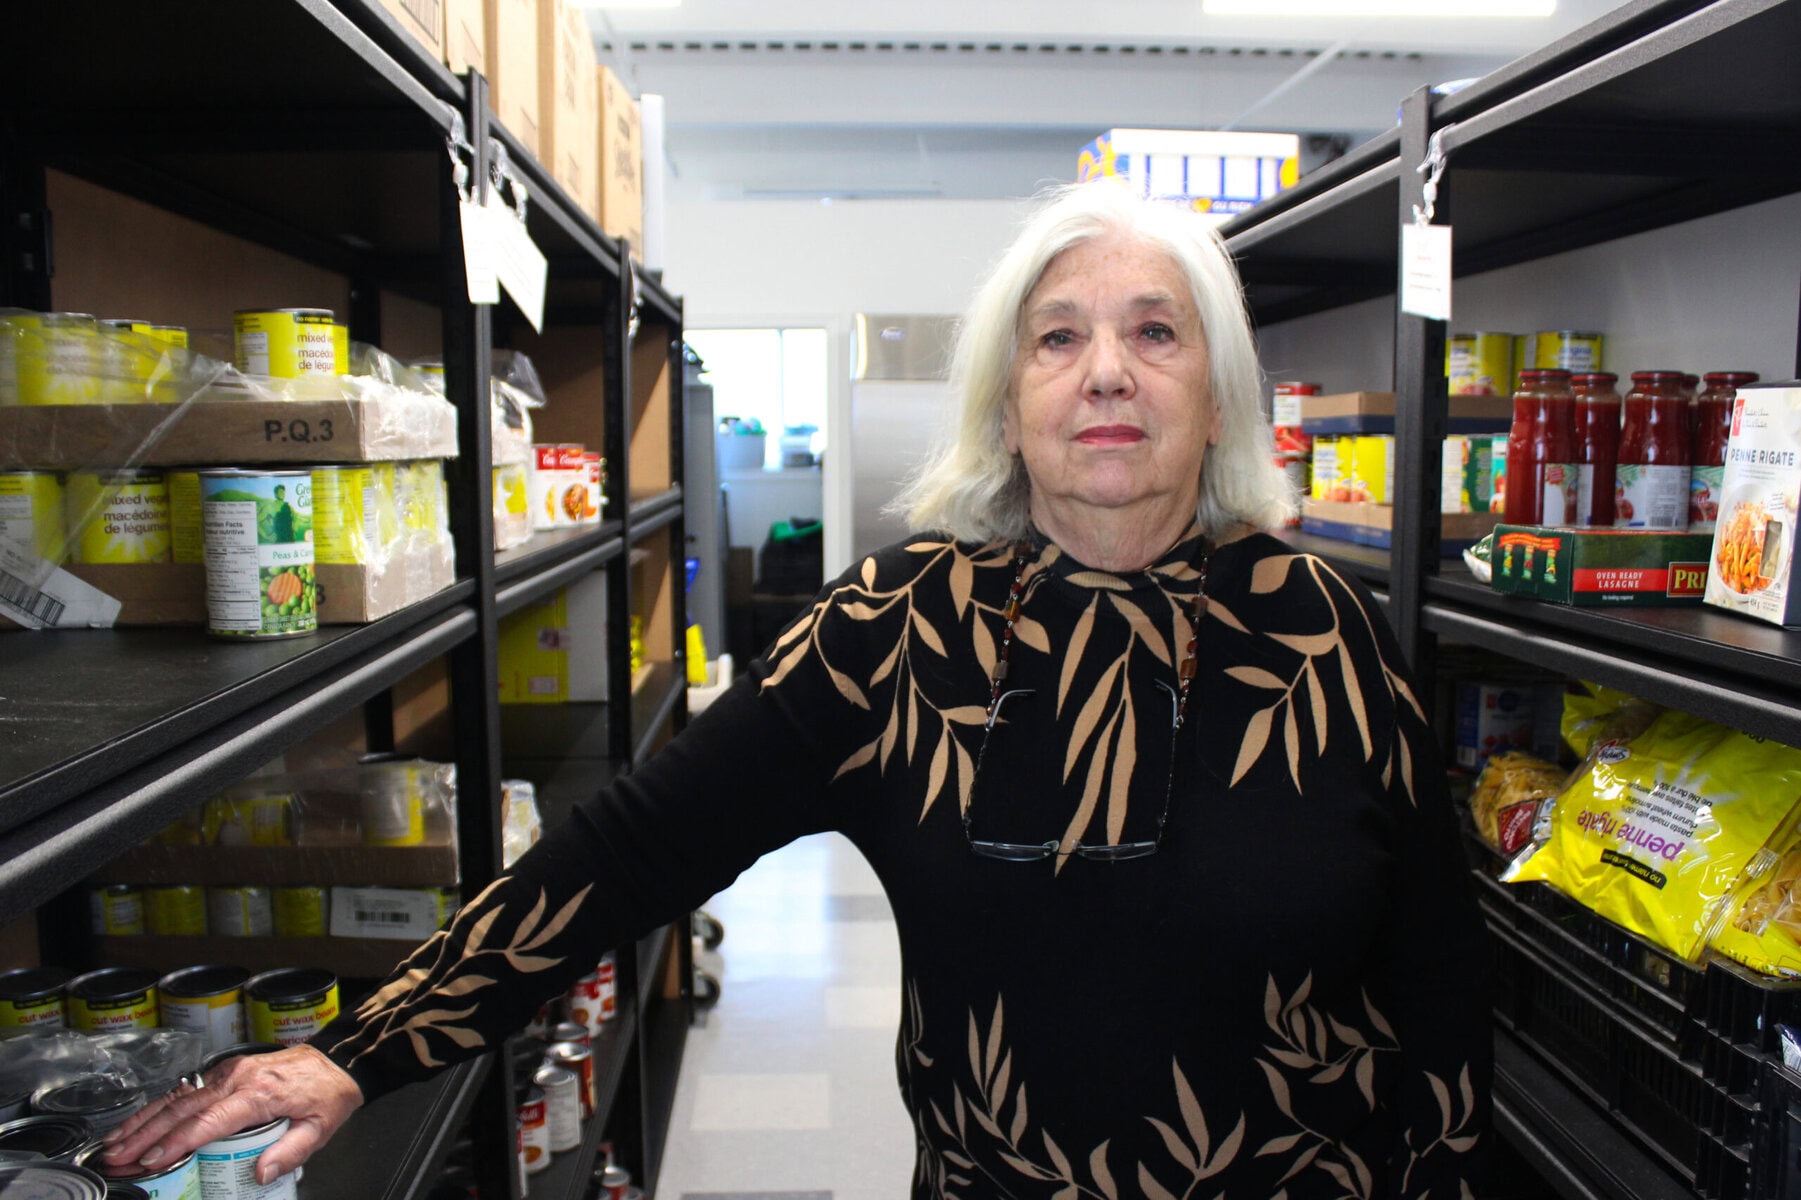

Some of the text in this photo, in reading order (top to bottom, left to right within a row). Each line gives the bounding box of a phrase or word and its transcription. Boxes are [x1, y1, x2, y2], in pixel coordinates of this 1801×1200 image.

[297, 333, 326, 343] mixed
[298, 360, 312, 370] de
[264, 419, 334, 443] P.Q.3
[1731, 448, 1795, 466] PENNE RIGATE
[104, 524, 121, 534] de
[273, 551, 291, 560] Peas
[293, 550, 299, 558] &
[1596, 572, 1643, 580] OVEN READY
[1598, 580, 1640, 589] LASAGNE
[1677, 787, 1688, 797] dur
[1688, 791, 1701, 804] blé
[1652, 805, 1673, 817] wheat
[1577, 809, 1618, 838] rigate
[1649, 815, 1669, 828] made
[1672, 813, 1698, 829] durum
[1670, 823, 1694, 838] pasta
[1617, 823, 1685, 862] penne
[1650, 873, 1662, 884] no
[19, 1014, 37, 1024] cut
[38, 1009, 61, 1020] wax
[92, 1016, 110, 1025] cut
[110, 1014, 132, 1024] wax
[273, 1017, 290, 1027] cut
[293, 1014, 314, 1025] wax
